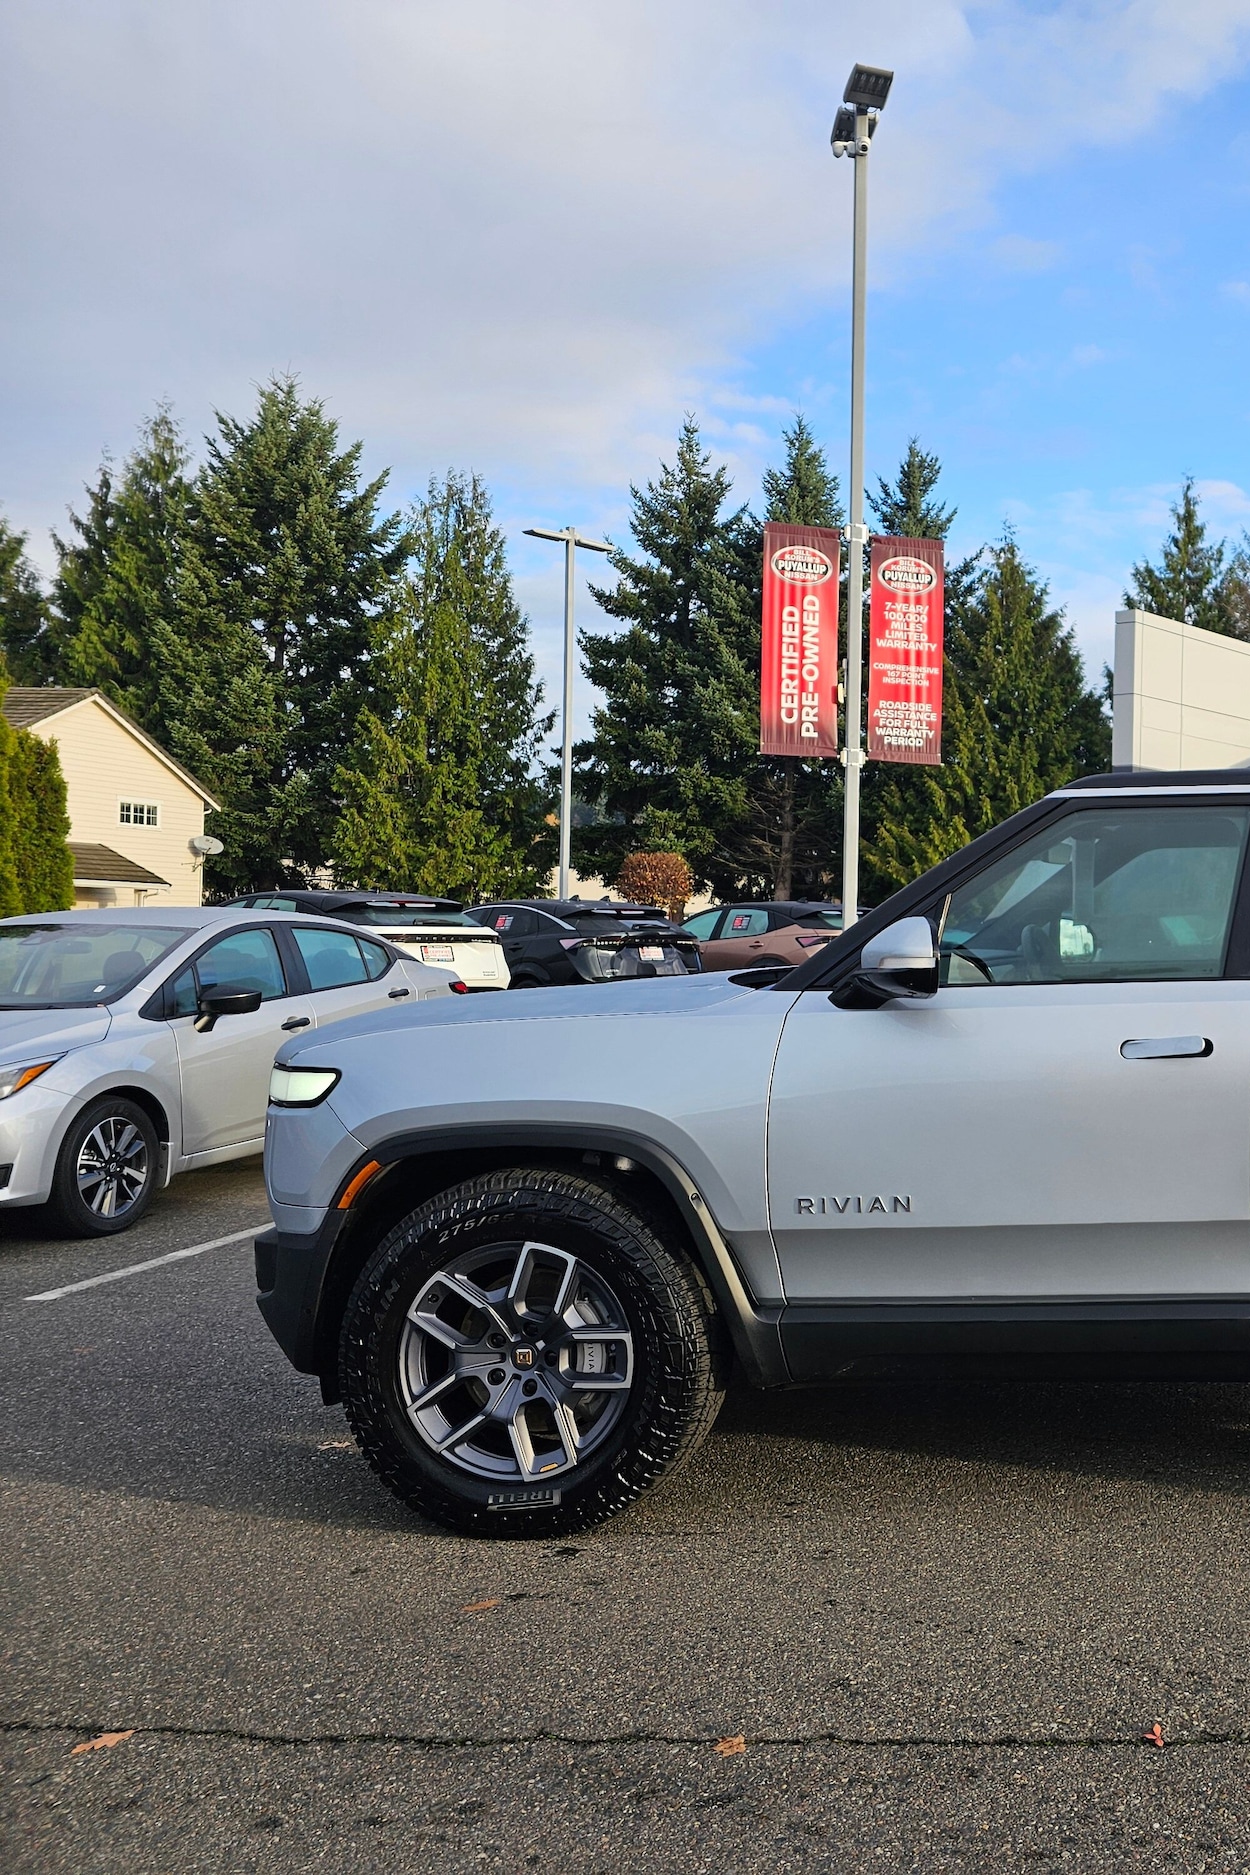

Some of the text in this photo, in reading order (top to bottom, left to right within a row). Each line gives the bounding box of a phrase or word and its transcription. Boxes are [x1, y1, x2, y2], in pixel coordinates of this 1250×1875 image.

[778, 560, 827, 574] PUYALLUP
[890, 564, 926, 573] KORUM'S
[899, 559, 916, 567] BILL
[784, 571, 818, 580] NISSAN
[884, 571, 932, 584] PUYALLUP
[890, 581, 923, 590] NISSAN
[885, 602, 929, 614] 7-YEAR/
[884, 611, 928, 623] 100,000
[890, 621, 923, 631] MILES
[885, 630, 928, 642] LIMITED
[876, 638, 937, 652] WARRANTY
[781, 605, 800, 724] CERTIFIED
[801, 594, 820, 738] PRE-OWNED
[873, 662, 940, 674] COMPREHENSIVE
[882, 677, 930, 687] INSPECTION
[879, 700, 933, 712] ROADSIDE
[873, 709, 937, 721] ASSISTANCE
[879, 718, 929, 729] FOR FULL
[875, 726, 935, 739] WARRANTY
[883, 736, 924, 747] PERIOD
[795, 1195, 912, 1214] RIVIAN
